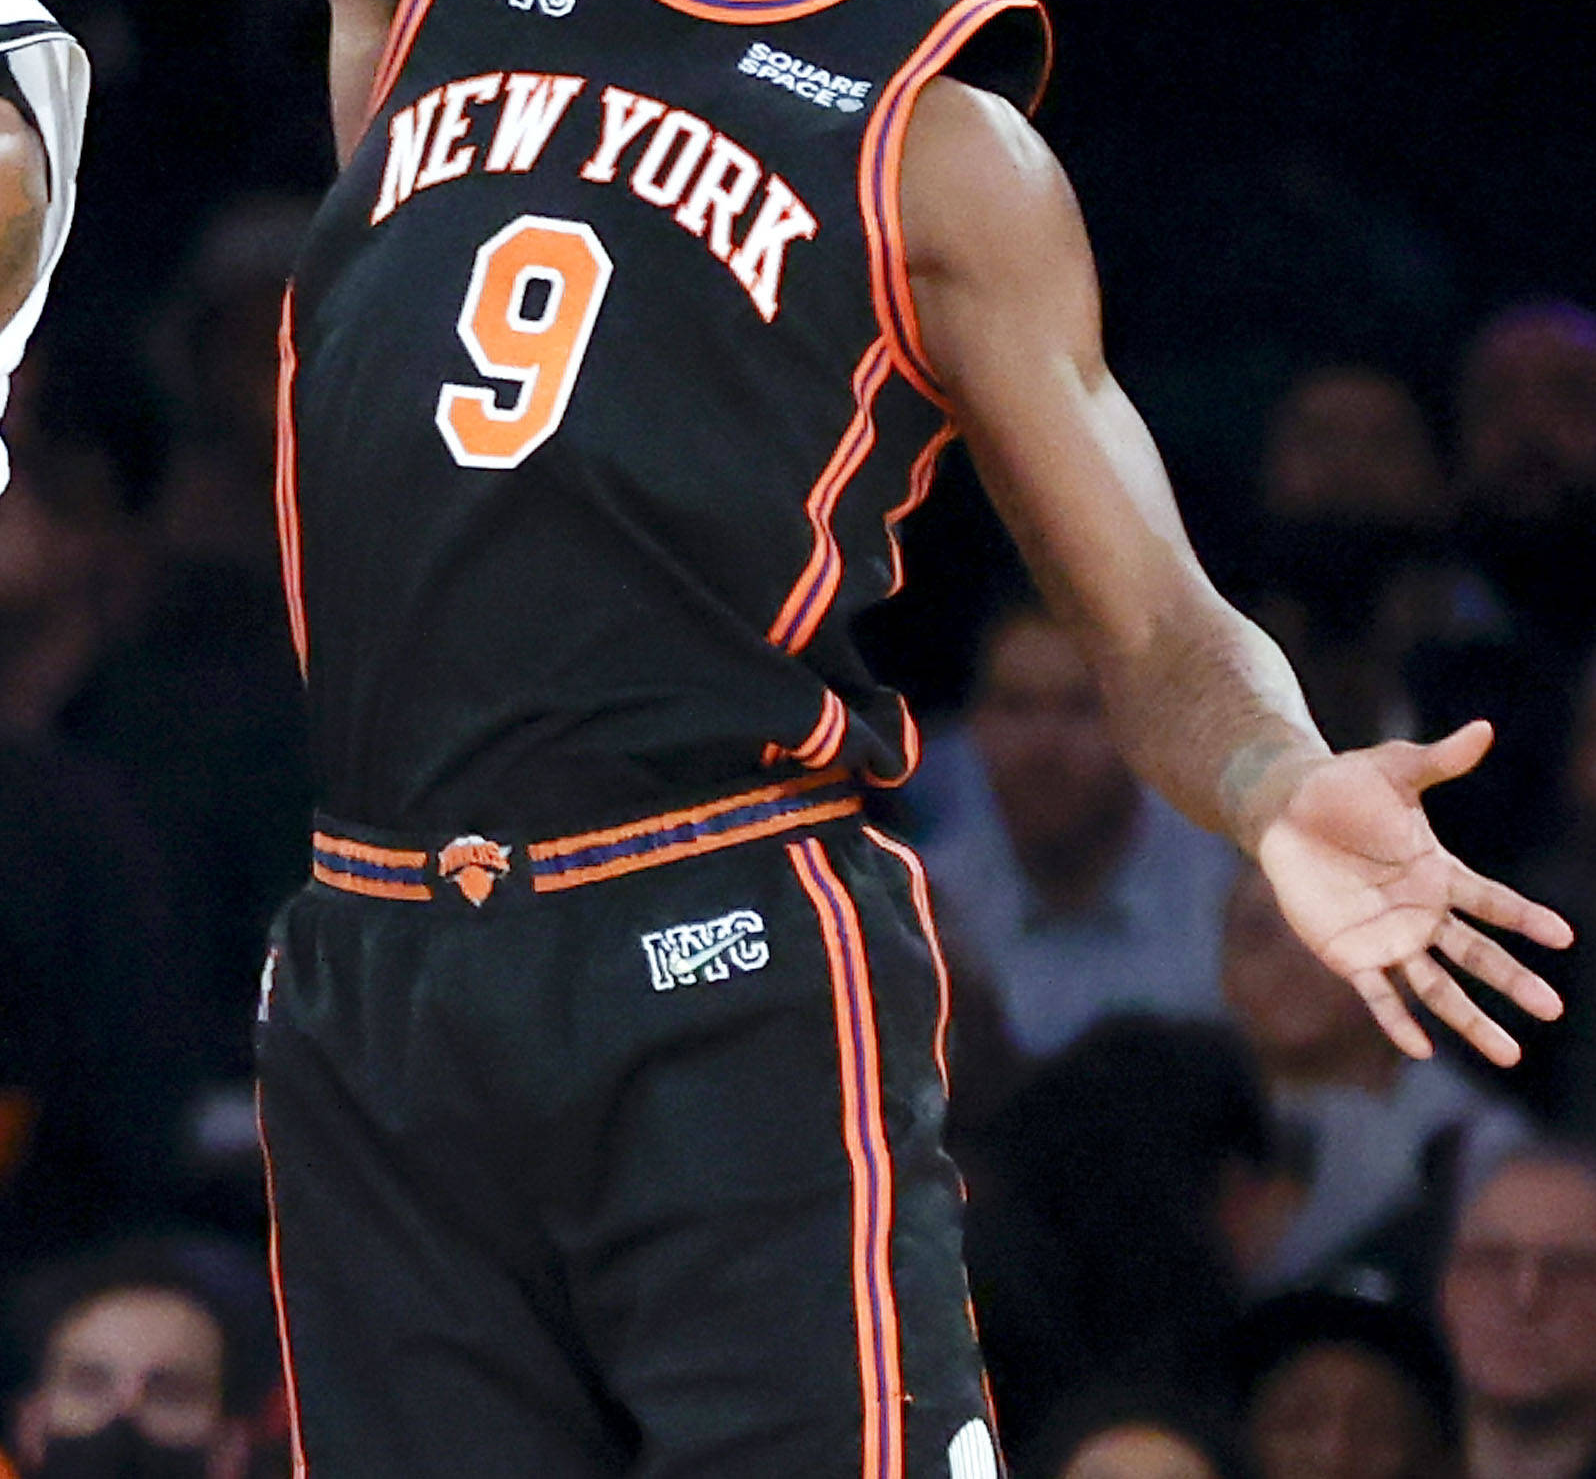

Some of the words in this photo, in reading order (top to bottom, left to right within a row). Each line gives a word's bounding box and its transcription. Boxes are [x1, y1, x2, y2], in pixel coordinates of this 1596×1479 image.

[738, 57, 838, 108] SPACE
[747, 42, 873, 98] SQUARE
[370, 71, 587, 227] NEW
[580, 84, 820, 324] YORK
[435, 215, 614, 469] 9
